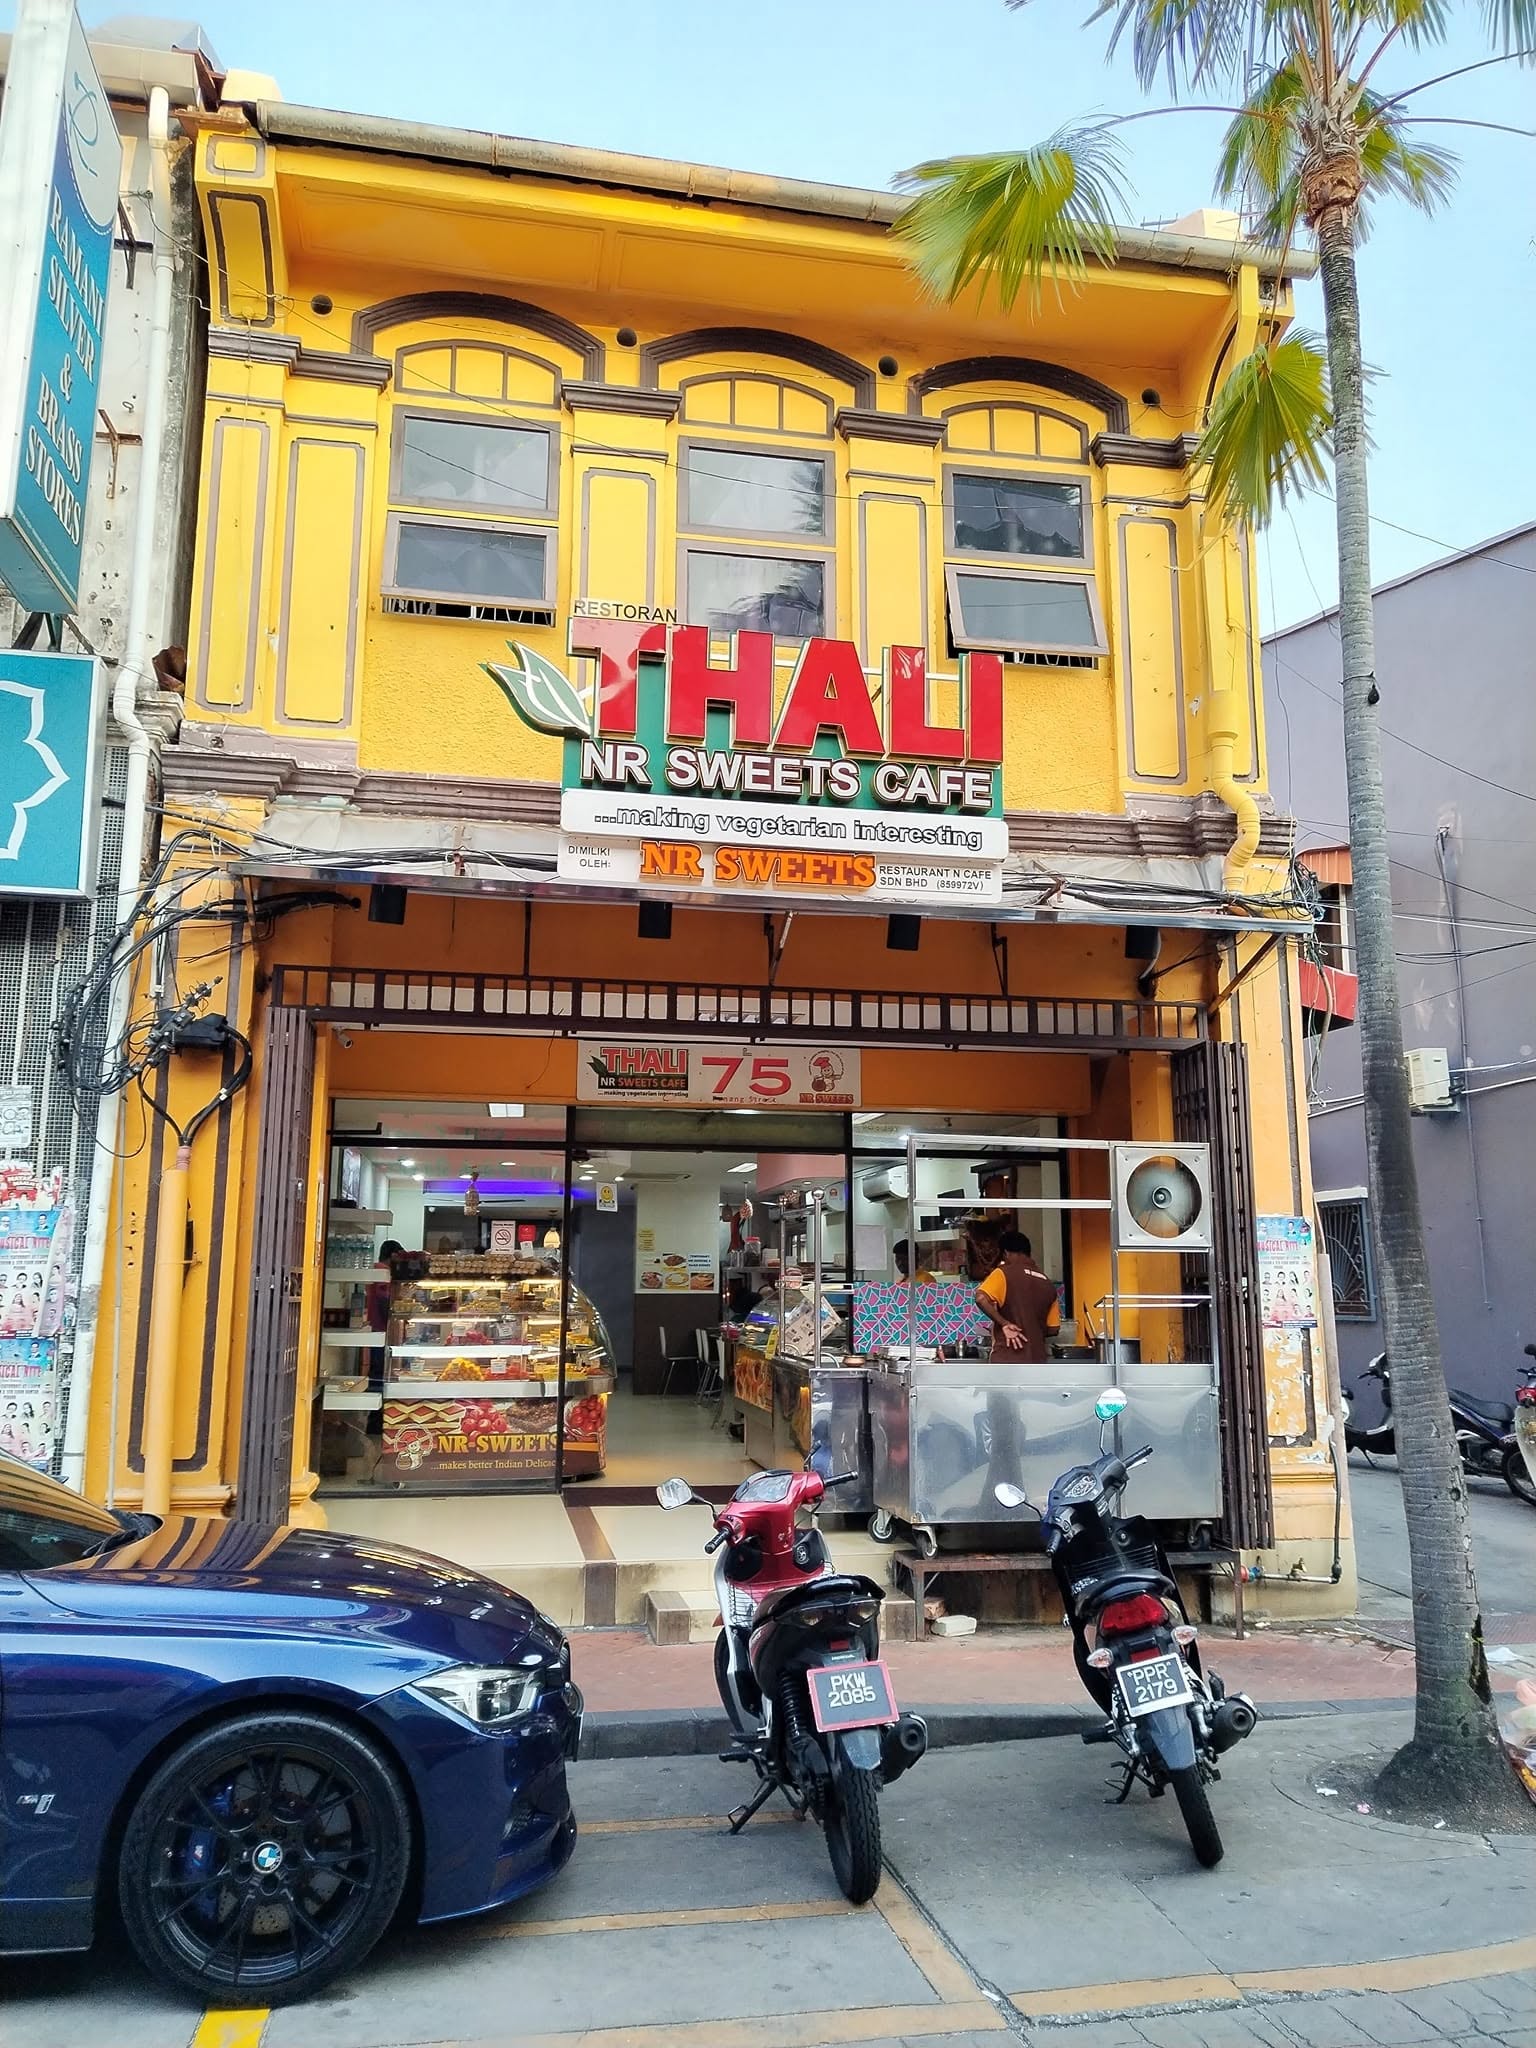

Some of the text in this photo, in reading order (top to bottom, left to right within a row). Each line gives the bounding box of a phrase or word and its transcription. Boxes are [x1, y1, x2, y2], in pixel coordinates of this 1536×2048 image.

[51, 183, 105, 338] RAMAN
[47, 254, 96, 386] SILVER
[60, 353, 73, 403] &
[37, 371, 83, 485] BRASS
[26, 424, 82, 546] STORES
[573, 600, 678, 623] RESTORAN
[569, 616, 1004, 766] THALI
[581, 740, 993, 808] NR SWEETS CAFE
[716, 815, 847, 839] vegetarian
[854, 820, 983, 851] interesting
[568, 845, 611, 857] DIMILIKI
[579, 859, 611, 869] OLEH:
[640, 840, 877, 888] NR SWEETS
[879, 865, 992, 880] RESTAURANT N CAFE
[880, 876, 984, 891] SDN BHD (859972V)
[601, 1047, 689, 1075] THALI
[600, 1077, 686, 1088] NR SWEETS CAFE
[702, 1056, 792, 1097] 75
[800, 1093, 854, 1105] NR SWEETS
[468, 1459, 493, 1470] better
[494, 1459, 523, 1470] Indian
[525, 1458, 566, 1469] Delicacs
[830, 1671, 866, 1693] PKW
[1135, 1678, 1178, 1703] 2179
[827, 1685, 876, 1708] 2085
